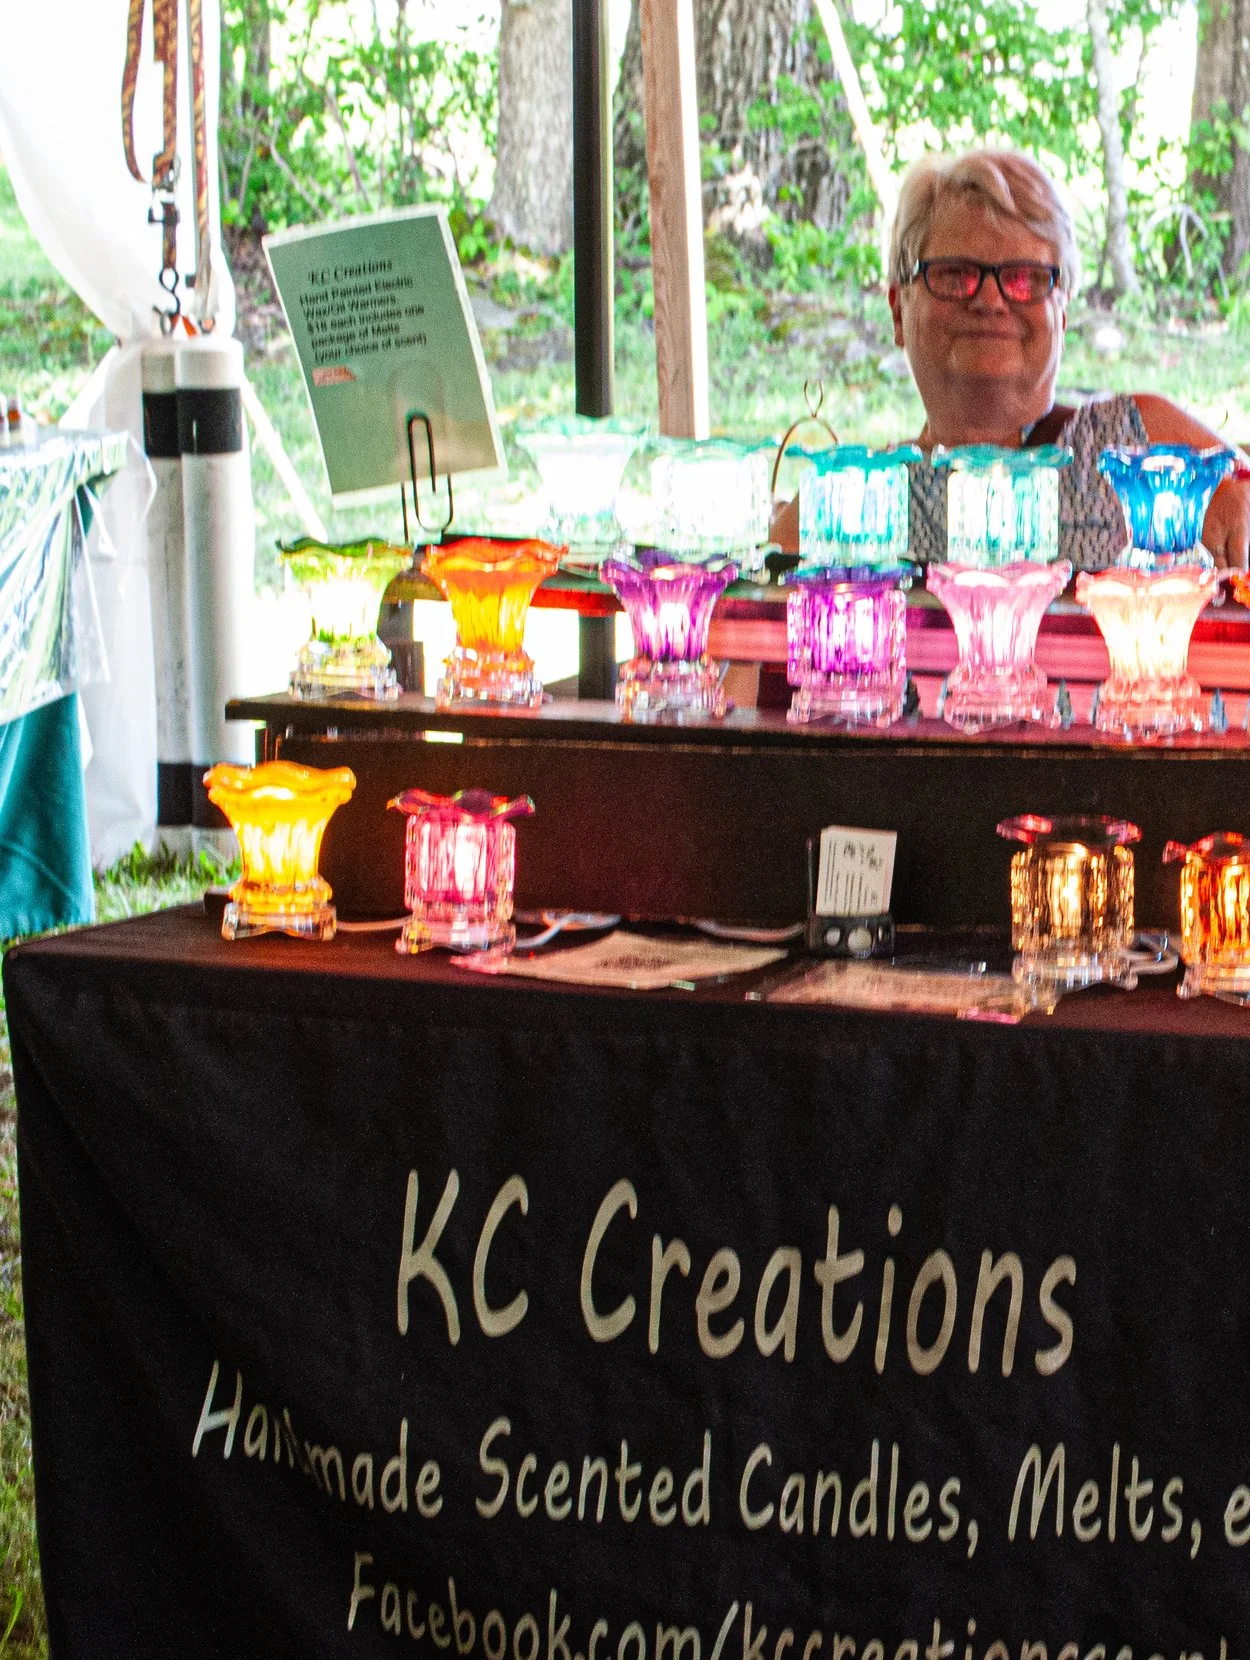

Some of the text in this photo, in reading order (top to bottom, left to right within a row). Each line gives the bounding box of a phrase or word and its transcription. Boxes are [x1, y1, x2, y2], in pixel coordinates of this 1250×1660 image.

[333, 259, 393, 283] Creations
[299, 275, 414, 307] Hand Painted Electric
[349, 294, 397, 312] Warmers
[397, 1168, 1077, 1377] KC Creations
[191, 1359, 444, 1519] Hanmade
[475, 1415, 711, 1527] Scented
[739, 1439, 979, 1558] Candles,
[1007, 1442, 1201, 1559] Melts,
